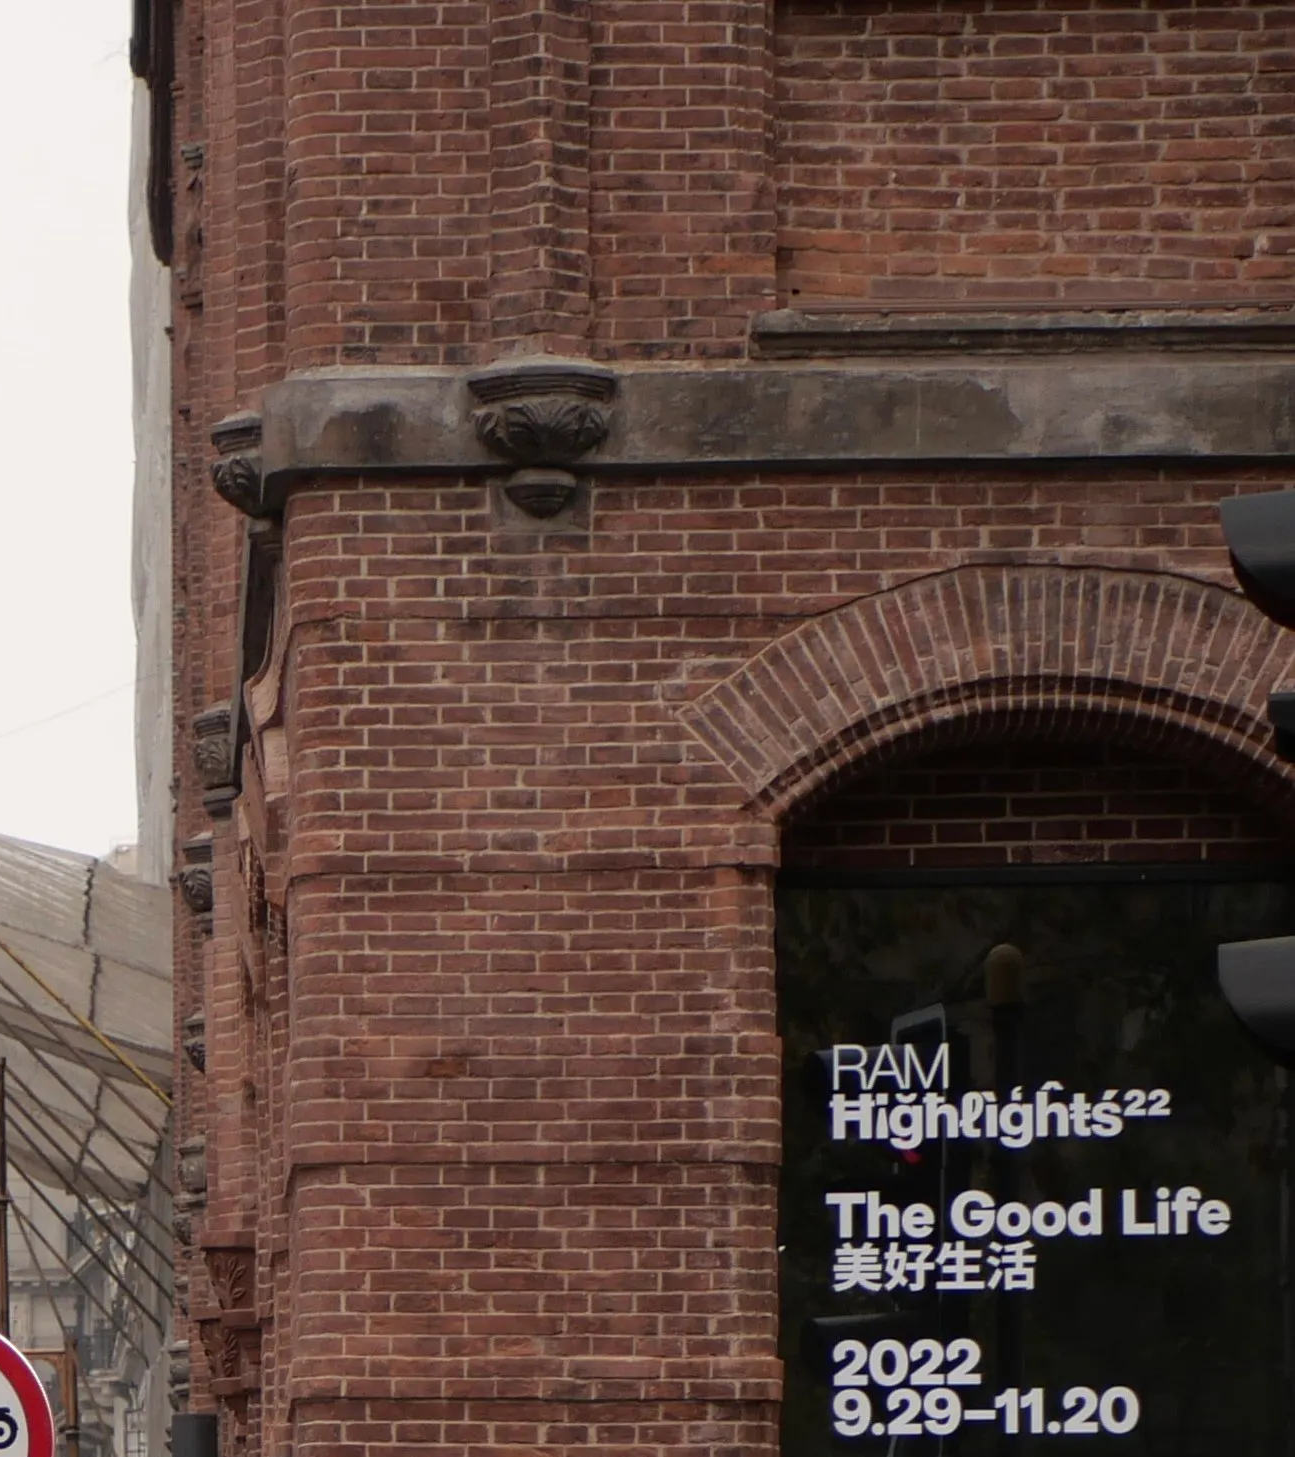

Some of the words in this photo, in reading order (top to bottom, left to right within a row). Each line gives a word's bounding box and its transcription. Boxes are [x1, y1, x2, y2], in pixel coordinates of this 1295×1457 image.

[832, 1042, 950, 1091] RAM
[825, 1190, 935, 1239] The
[950, 1188, 1103, 1238] Good
[1122, 1186, 1232, 1236] Life
[832, 1241, 1037, 1293] 美好生活
[832, 1338, 983, 1387] 2022
